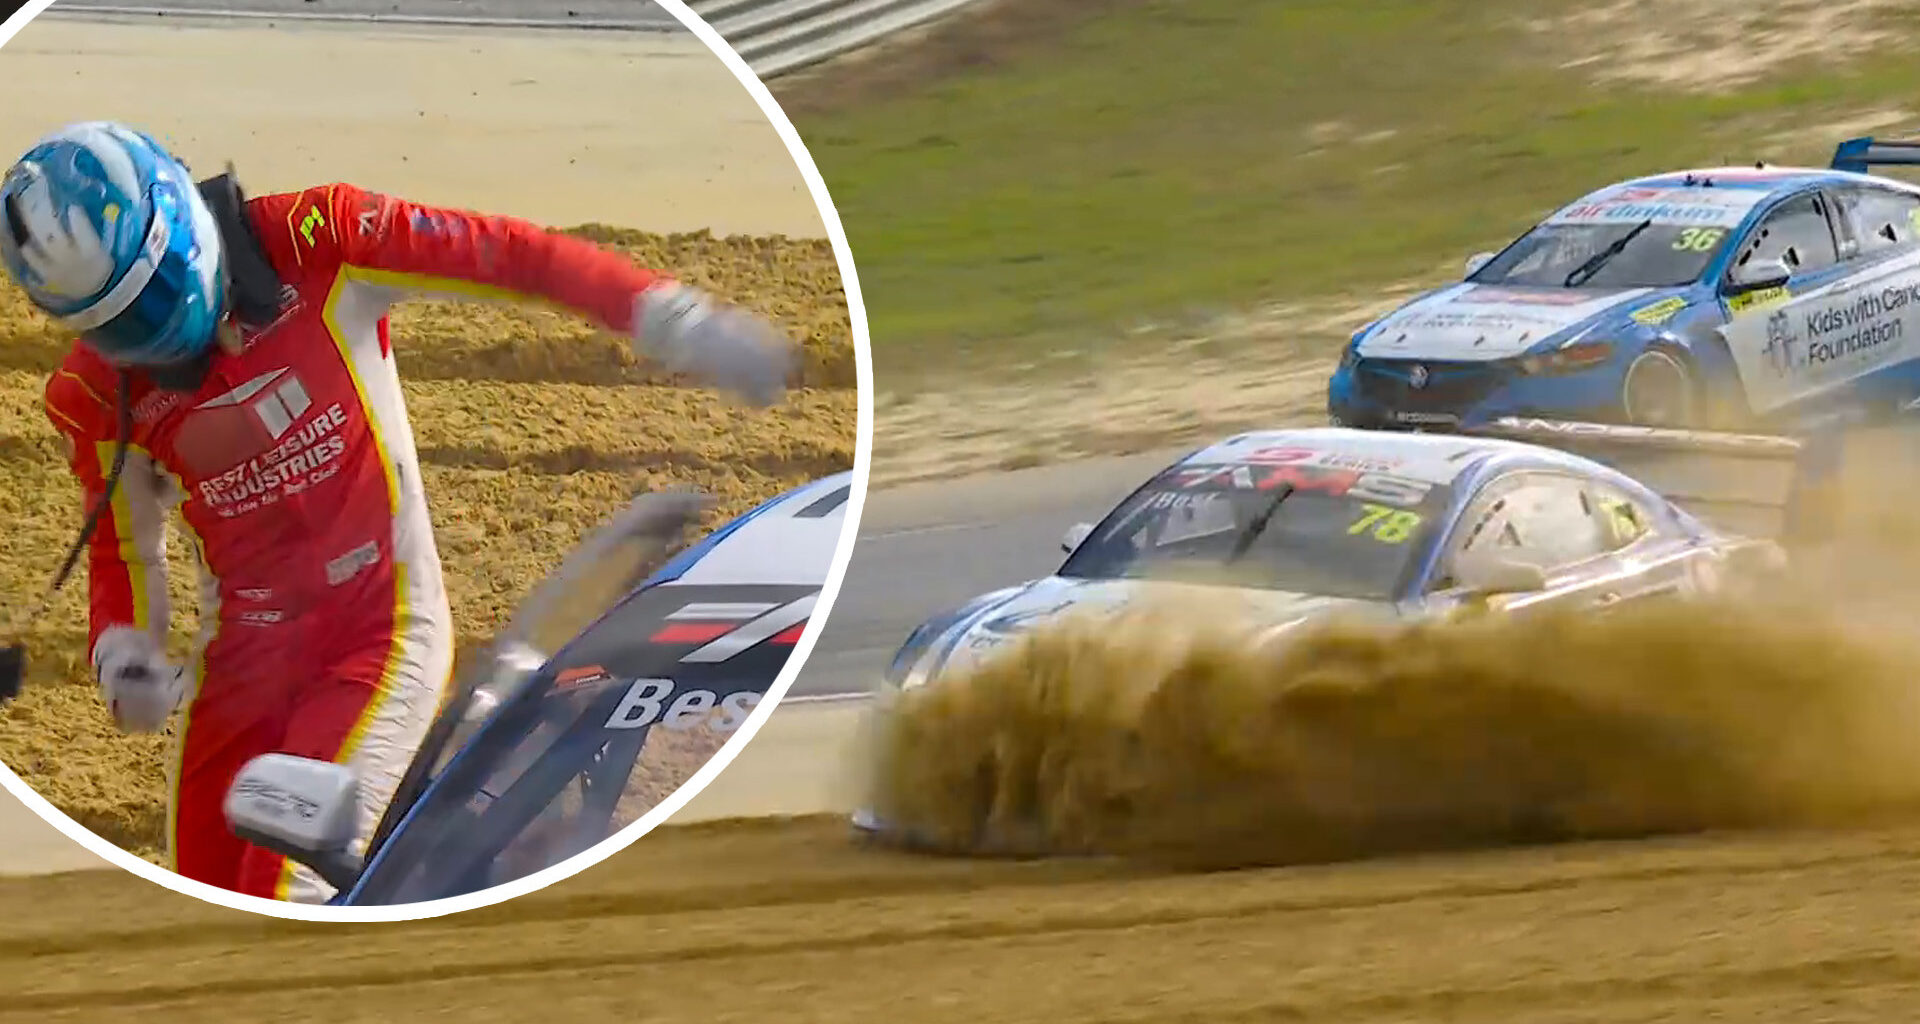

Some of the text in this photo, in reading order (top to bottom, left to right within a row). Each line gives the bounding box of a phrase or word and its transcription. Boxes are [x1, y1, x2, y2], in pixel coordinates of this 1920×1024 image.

[1672, 227, 1723, 251] 36
[1806, 307, 1843, 338] Kids
[1844, 290, 1881, 326] with
[1808, 317, 1903, 365] Foundation
[199, 462, 246, 496] BEST
[249, 402, 347, 475] LEISURE
[205, 435, 345, 507] INDUSTRIES
[1346, 502, 1420, 542] 78
